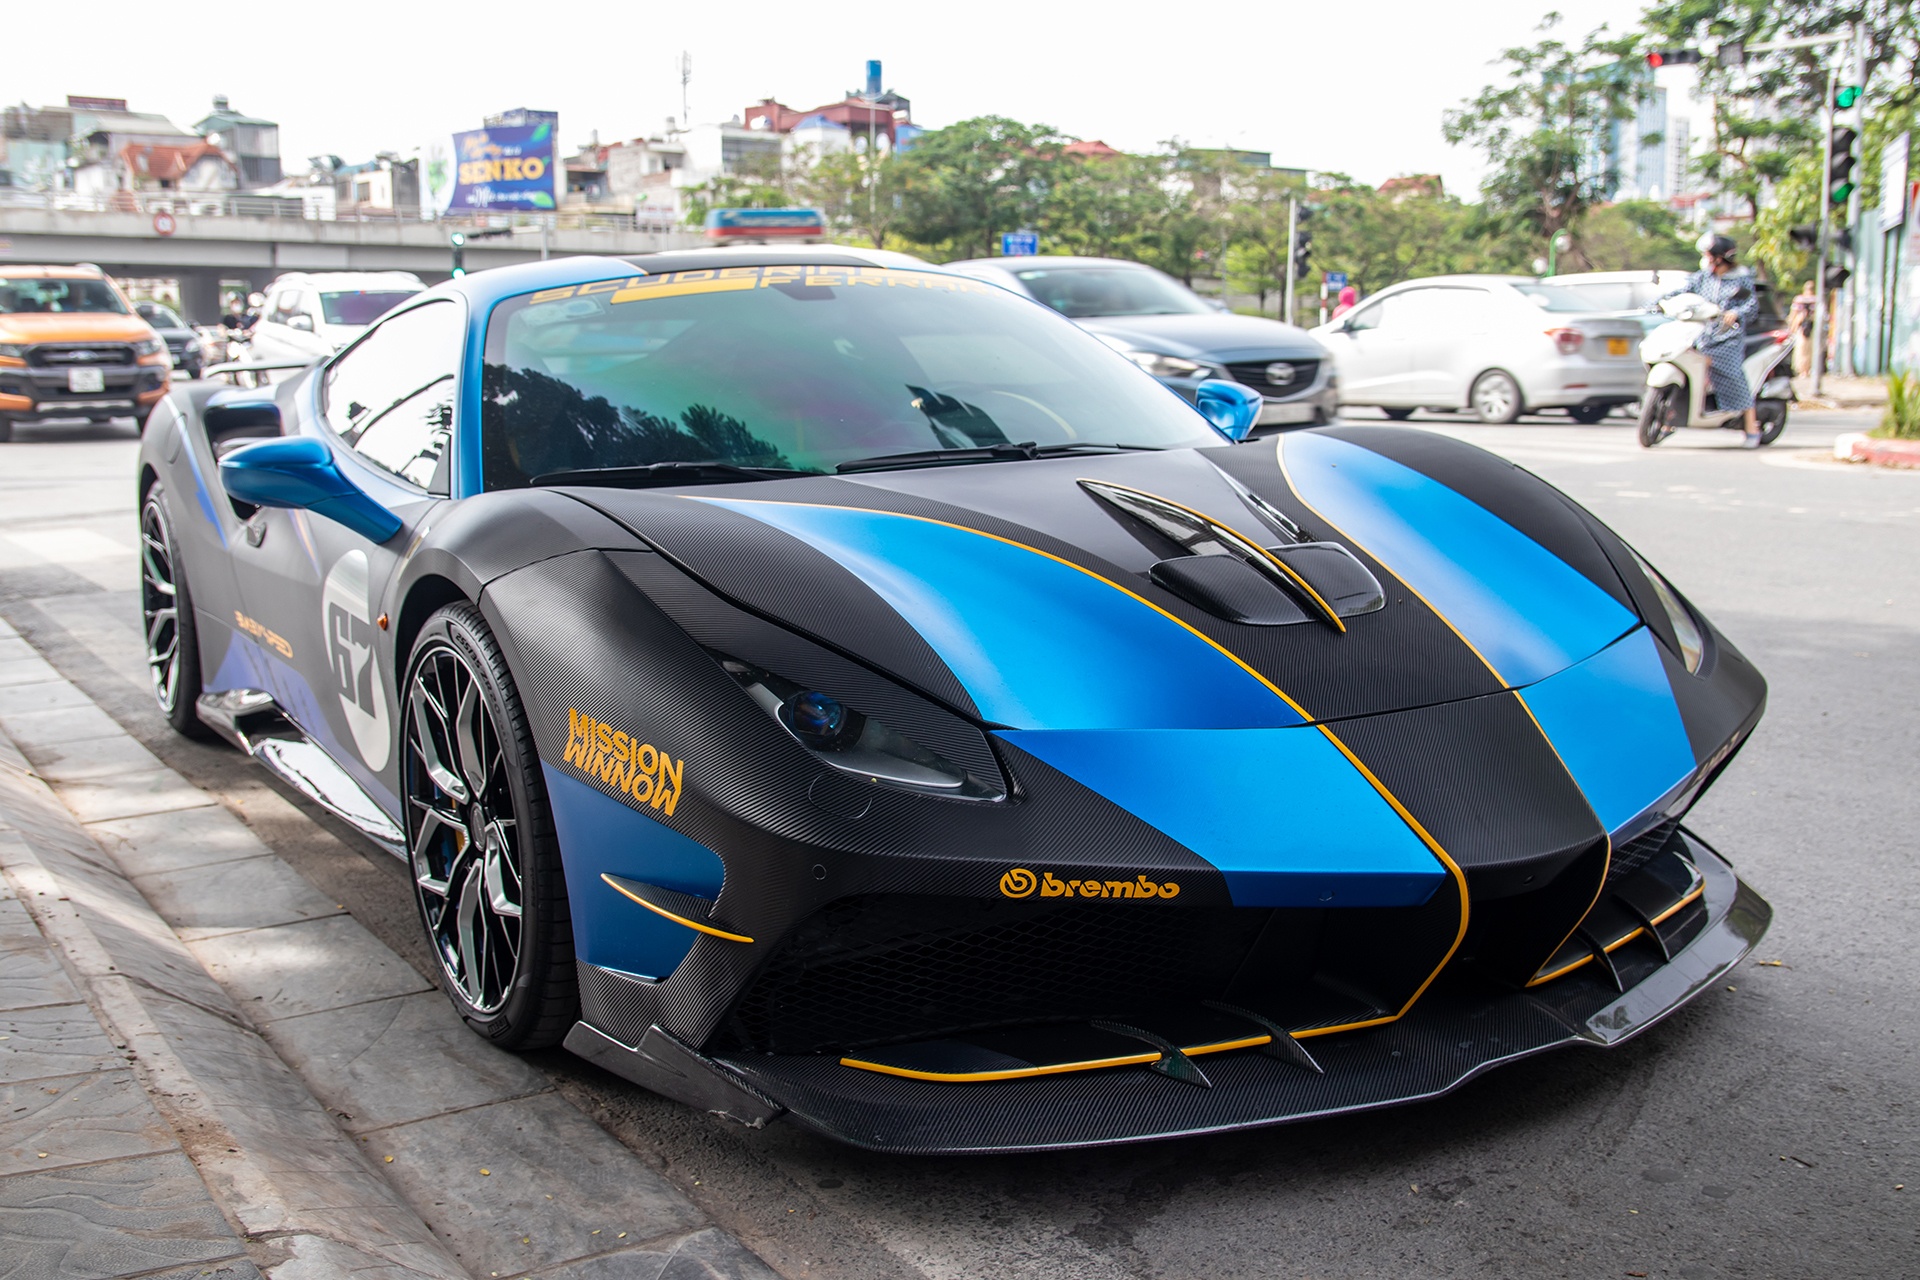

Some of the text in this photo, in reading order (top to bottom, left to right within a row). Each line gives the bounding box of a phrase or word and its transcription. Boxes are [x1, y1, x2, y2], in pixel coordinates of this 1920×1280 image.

[459, 156, 545, 185] SENKO
[529, 265, 851, 305] SCUDERIA
[330, 601, 377, 721] 67
[562, 736, 682, 817] WINNOW
[568, 707, 685, 790] MISSION
[1040, 872, 1181, 899] brembo
